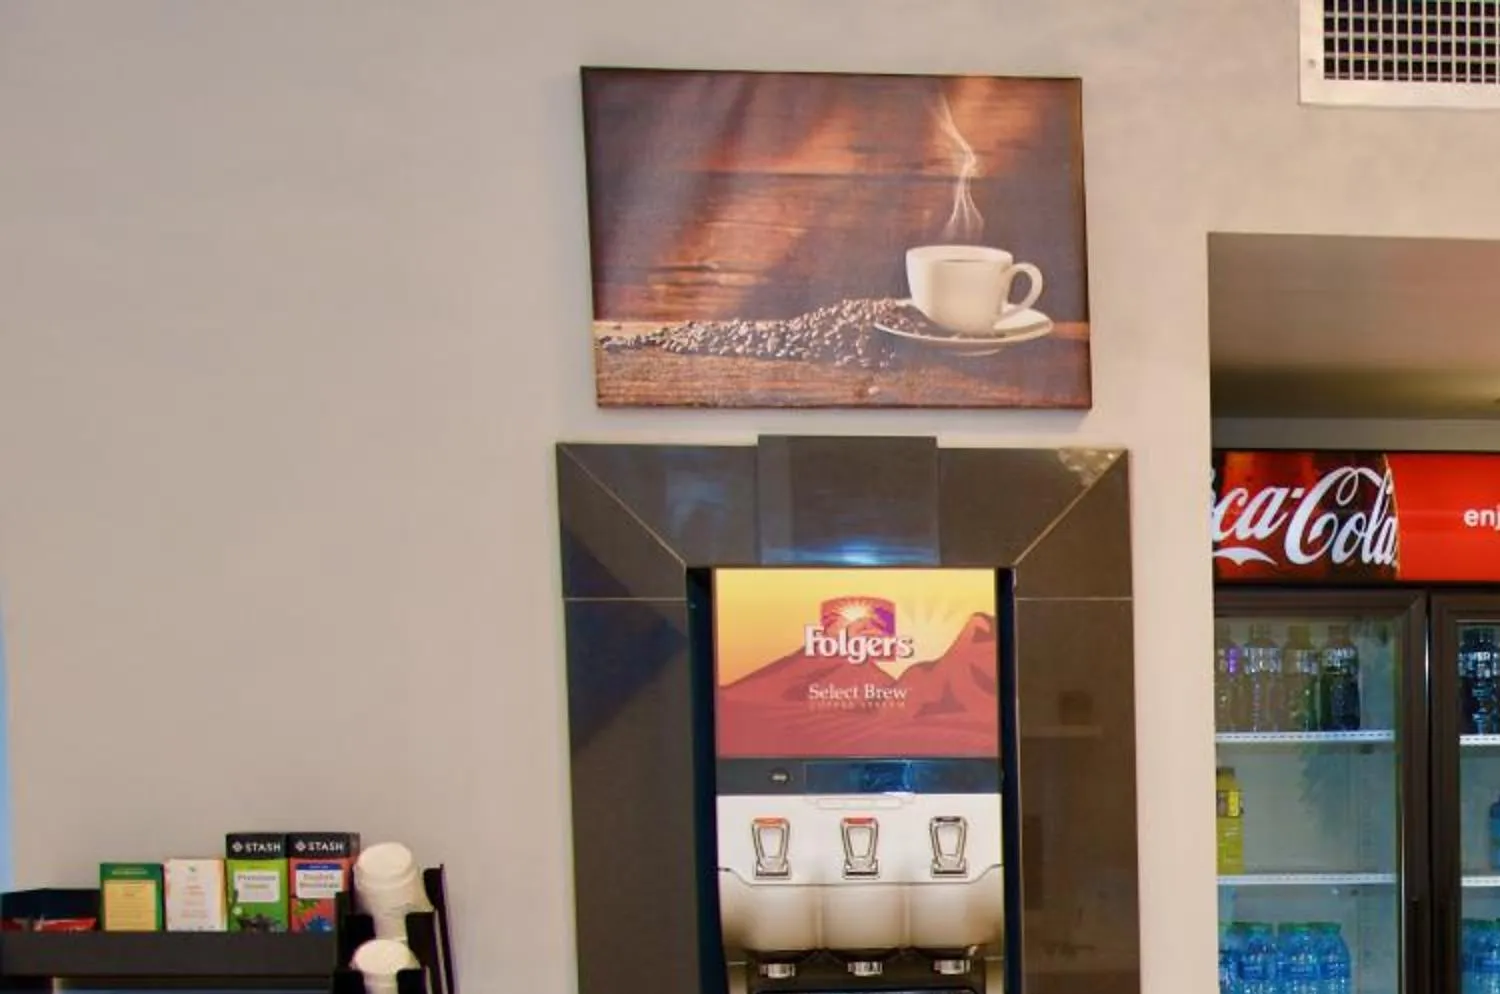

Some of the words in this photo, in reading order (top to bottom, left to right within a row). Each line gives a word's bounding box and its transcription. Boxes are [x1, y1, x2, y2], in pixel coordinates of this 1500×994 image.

[1212, 465, 1399, 567] ca-Cola
[804, 624, 915, 665] Folgers
[808, 683, 859, 700] Select
[863, 683, 908, 700] Brew
[244, 841, 281, 853] STASH
[307, 840, 344, 852] STASH
